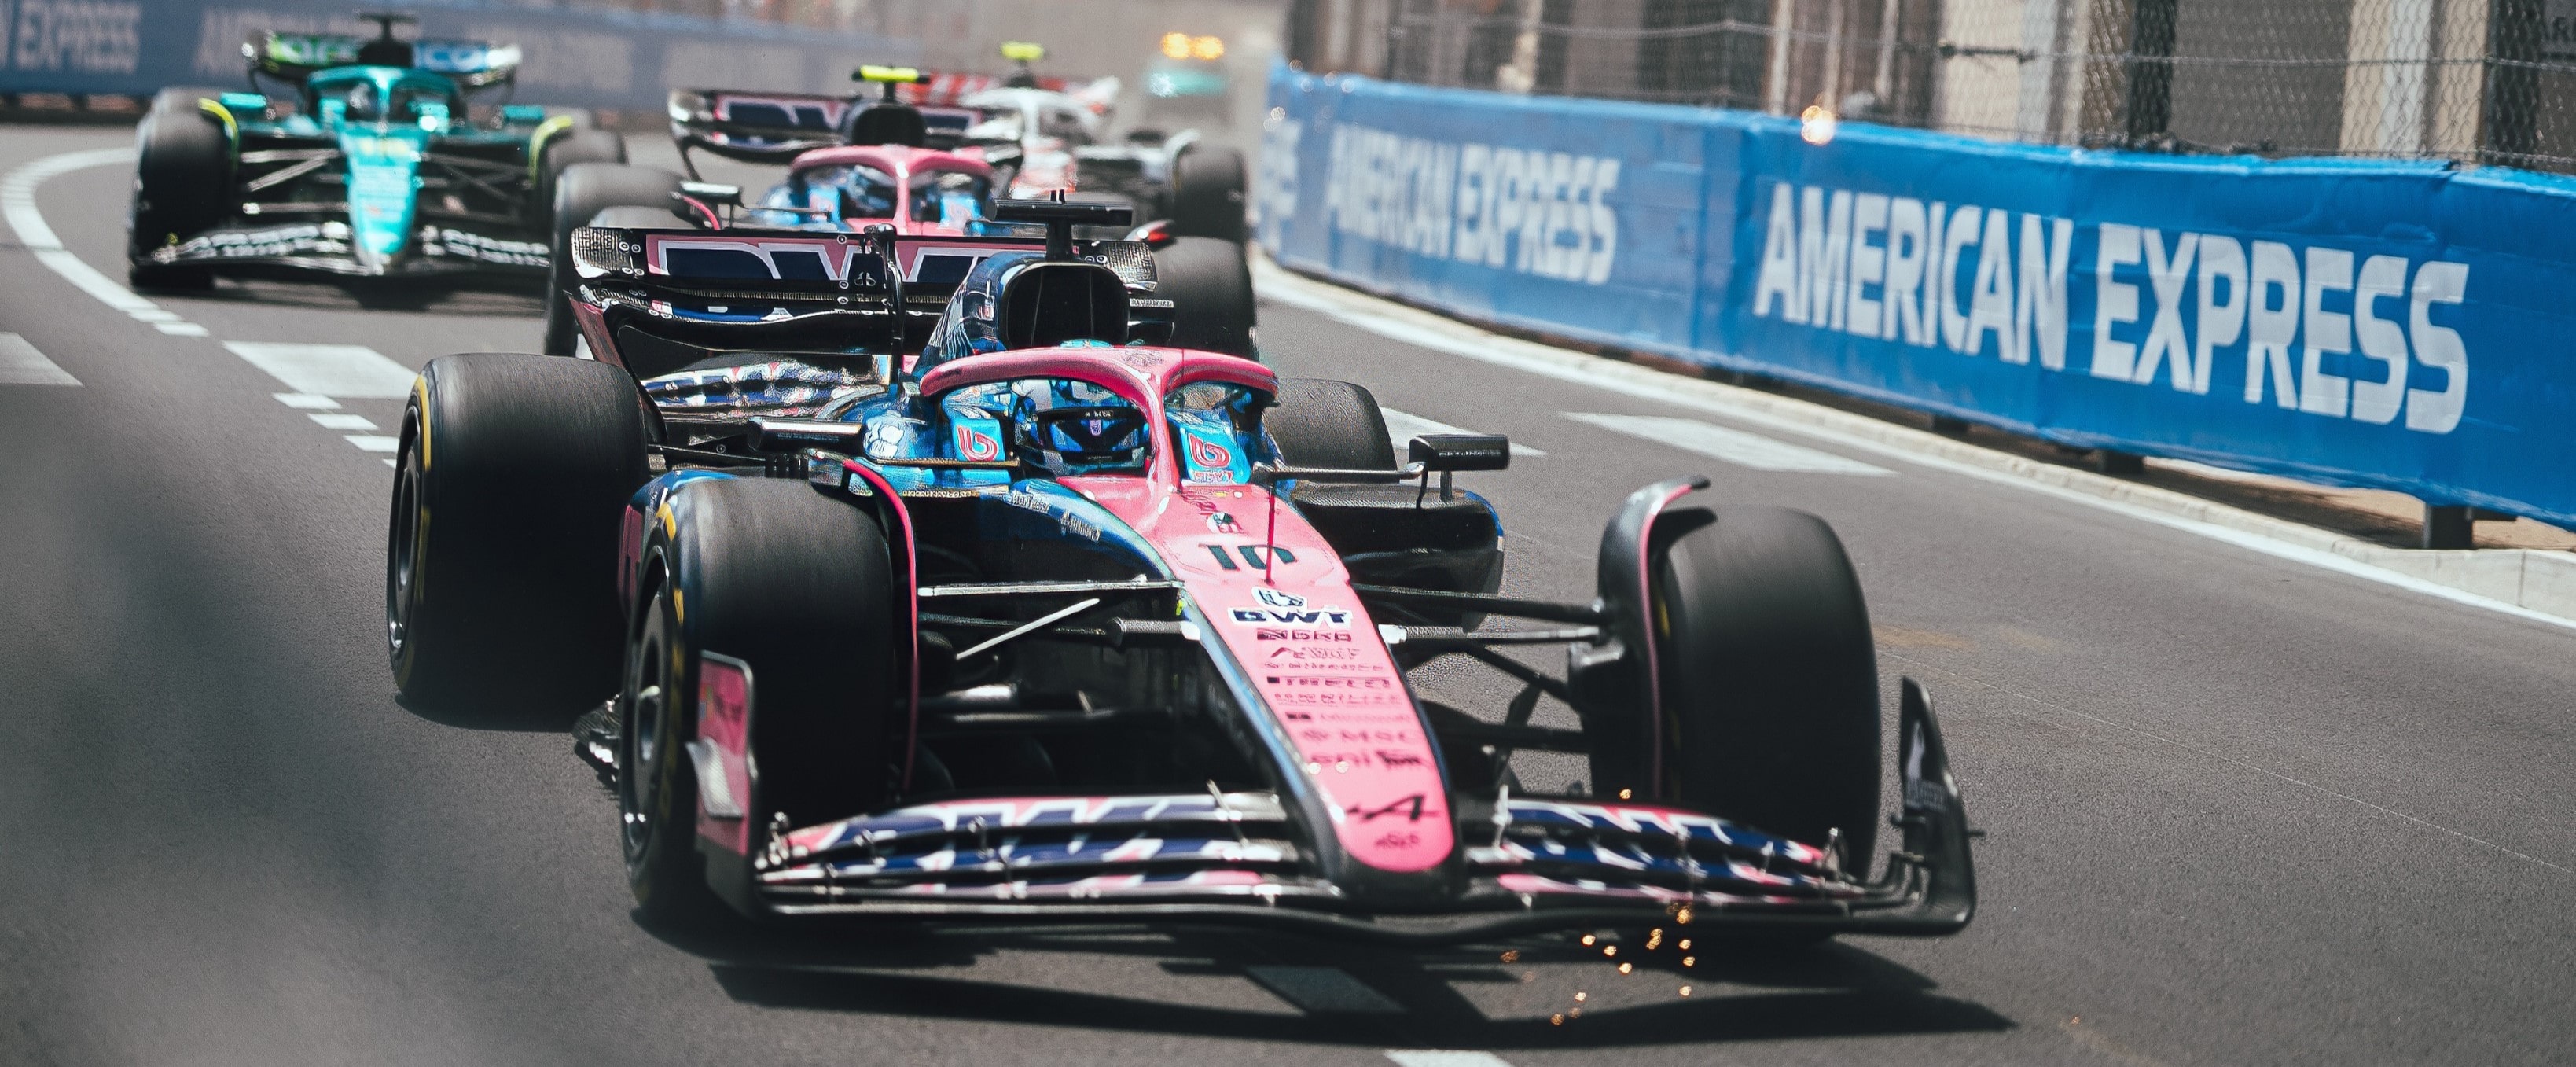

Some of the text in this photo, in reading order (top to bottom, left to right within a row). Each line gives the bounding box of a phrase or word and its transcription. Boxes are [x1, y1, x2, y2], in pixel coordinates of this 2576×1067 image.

[1325, 121, 1459, 261] AMERICAN
[1454, 143, 1621, 285] EXPRESS
[1754, 182, 2469, 436] AMERICAN EXPRESS
[1197, 543, 1299, 572] 10
[1230, 608, 1350, 626] BWT
